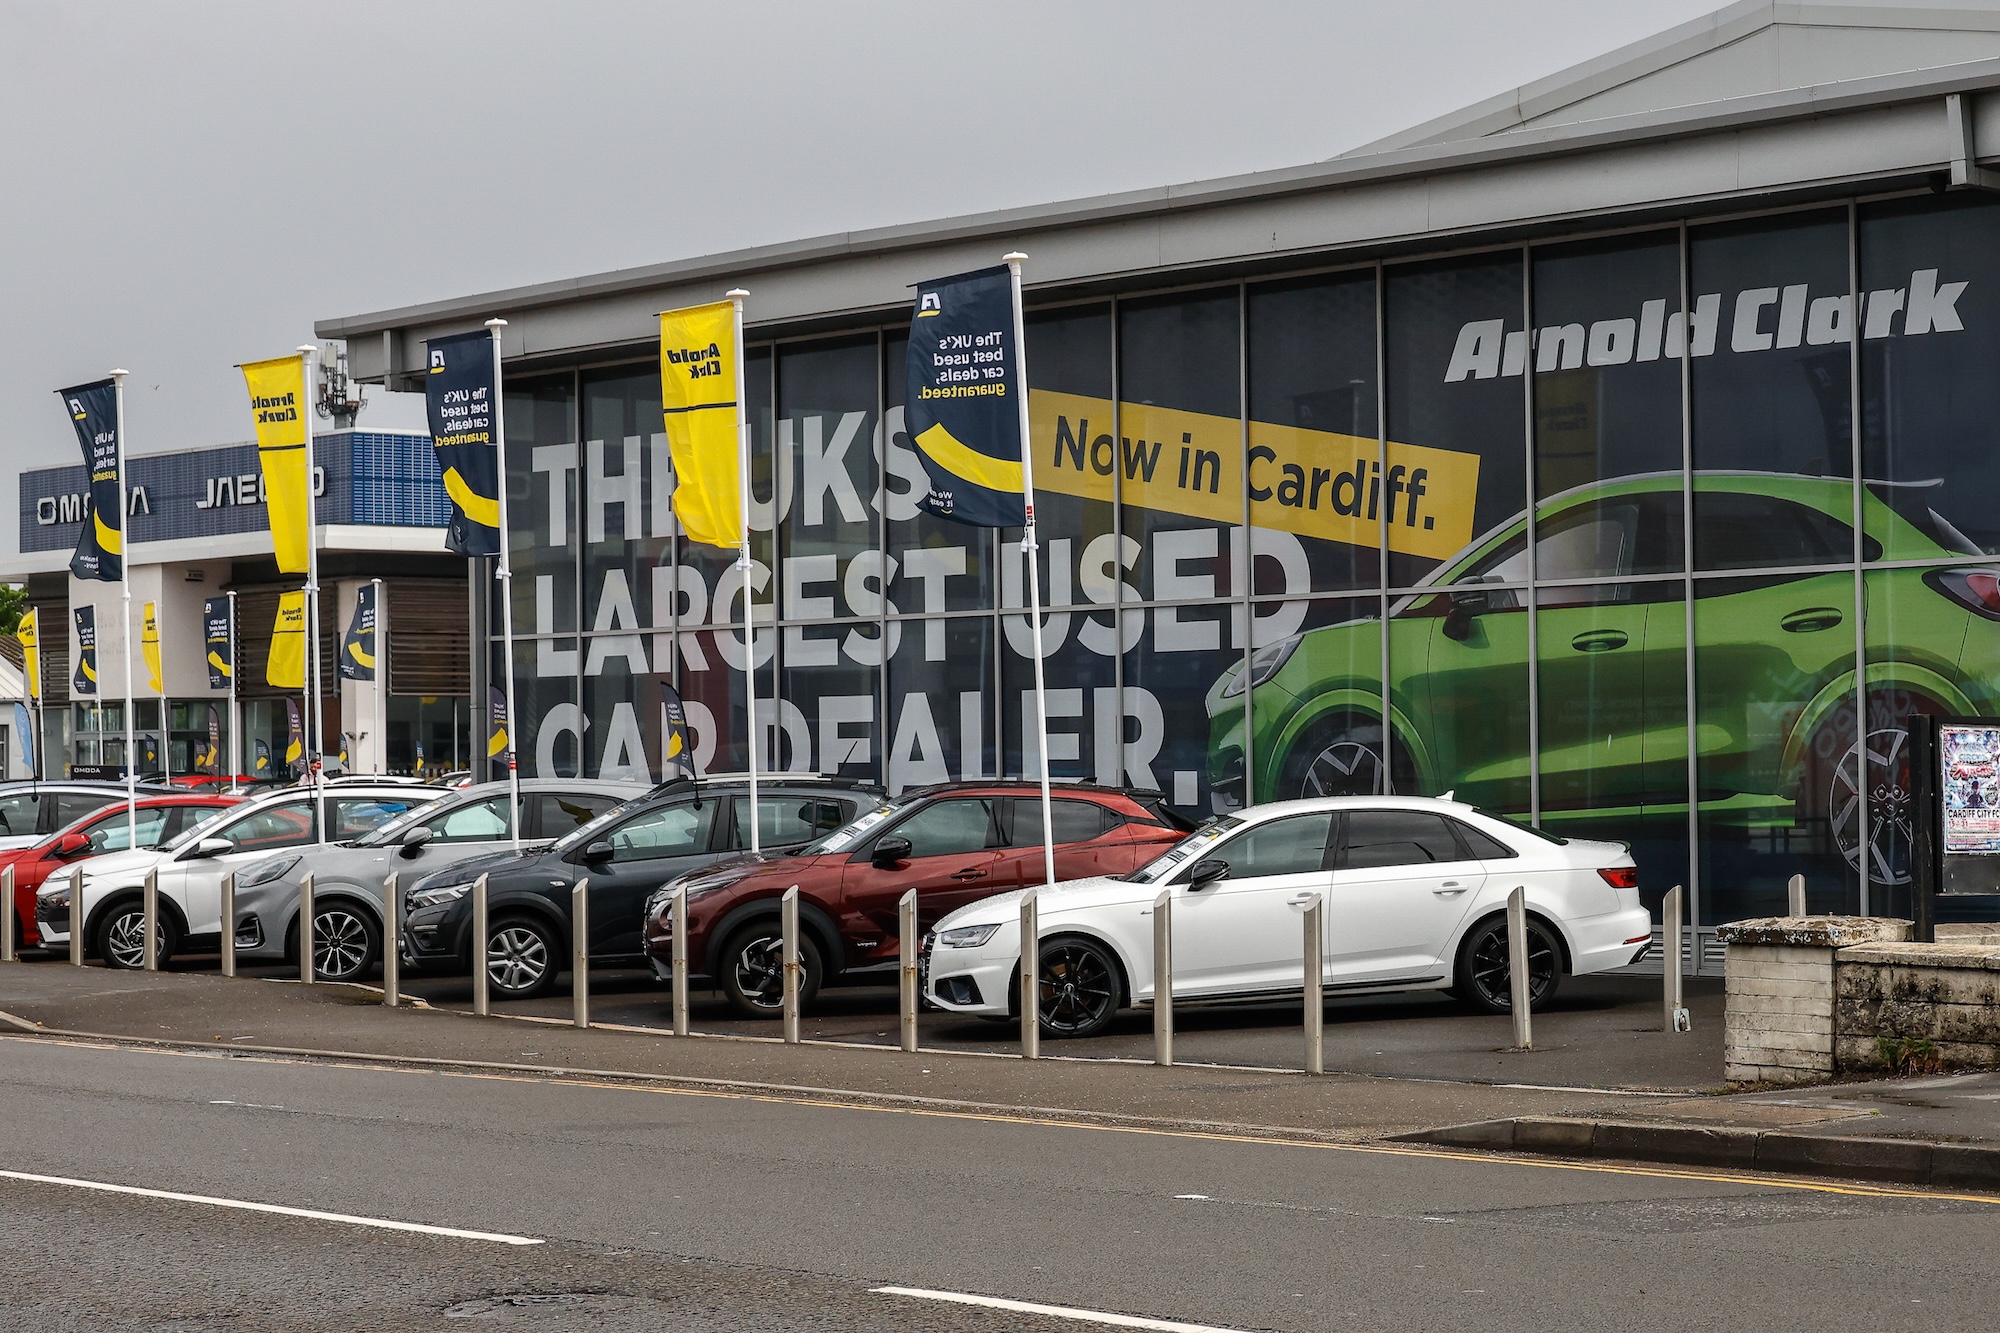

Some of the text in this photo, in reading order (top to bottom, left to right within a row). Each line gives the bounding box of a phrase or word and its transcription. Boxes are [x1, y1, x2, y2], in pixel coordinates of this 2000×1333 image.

[1443, 268, 1970, 383] Arnold Clark
[37, 486, 150, 525] OMA
[745, 405, 932, 532] UKS
[1053, 415, 1434, 531] Now in Cardiff.
[535, 525, 1311, 678] LARGEST USED
[535, 686, 1198, 806] CAR DEALER.
[1948, 809, 2000, 818] CARDIFF CITY FC
